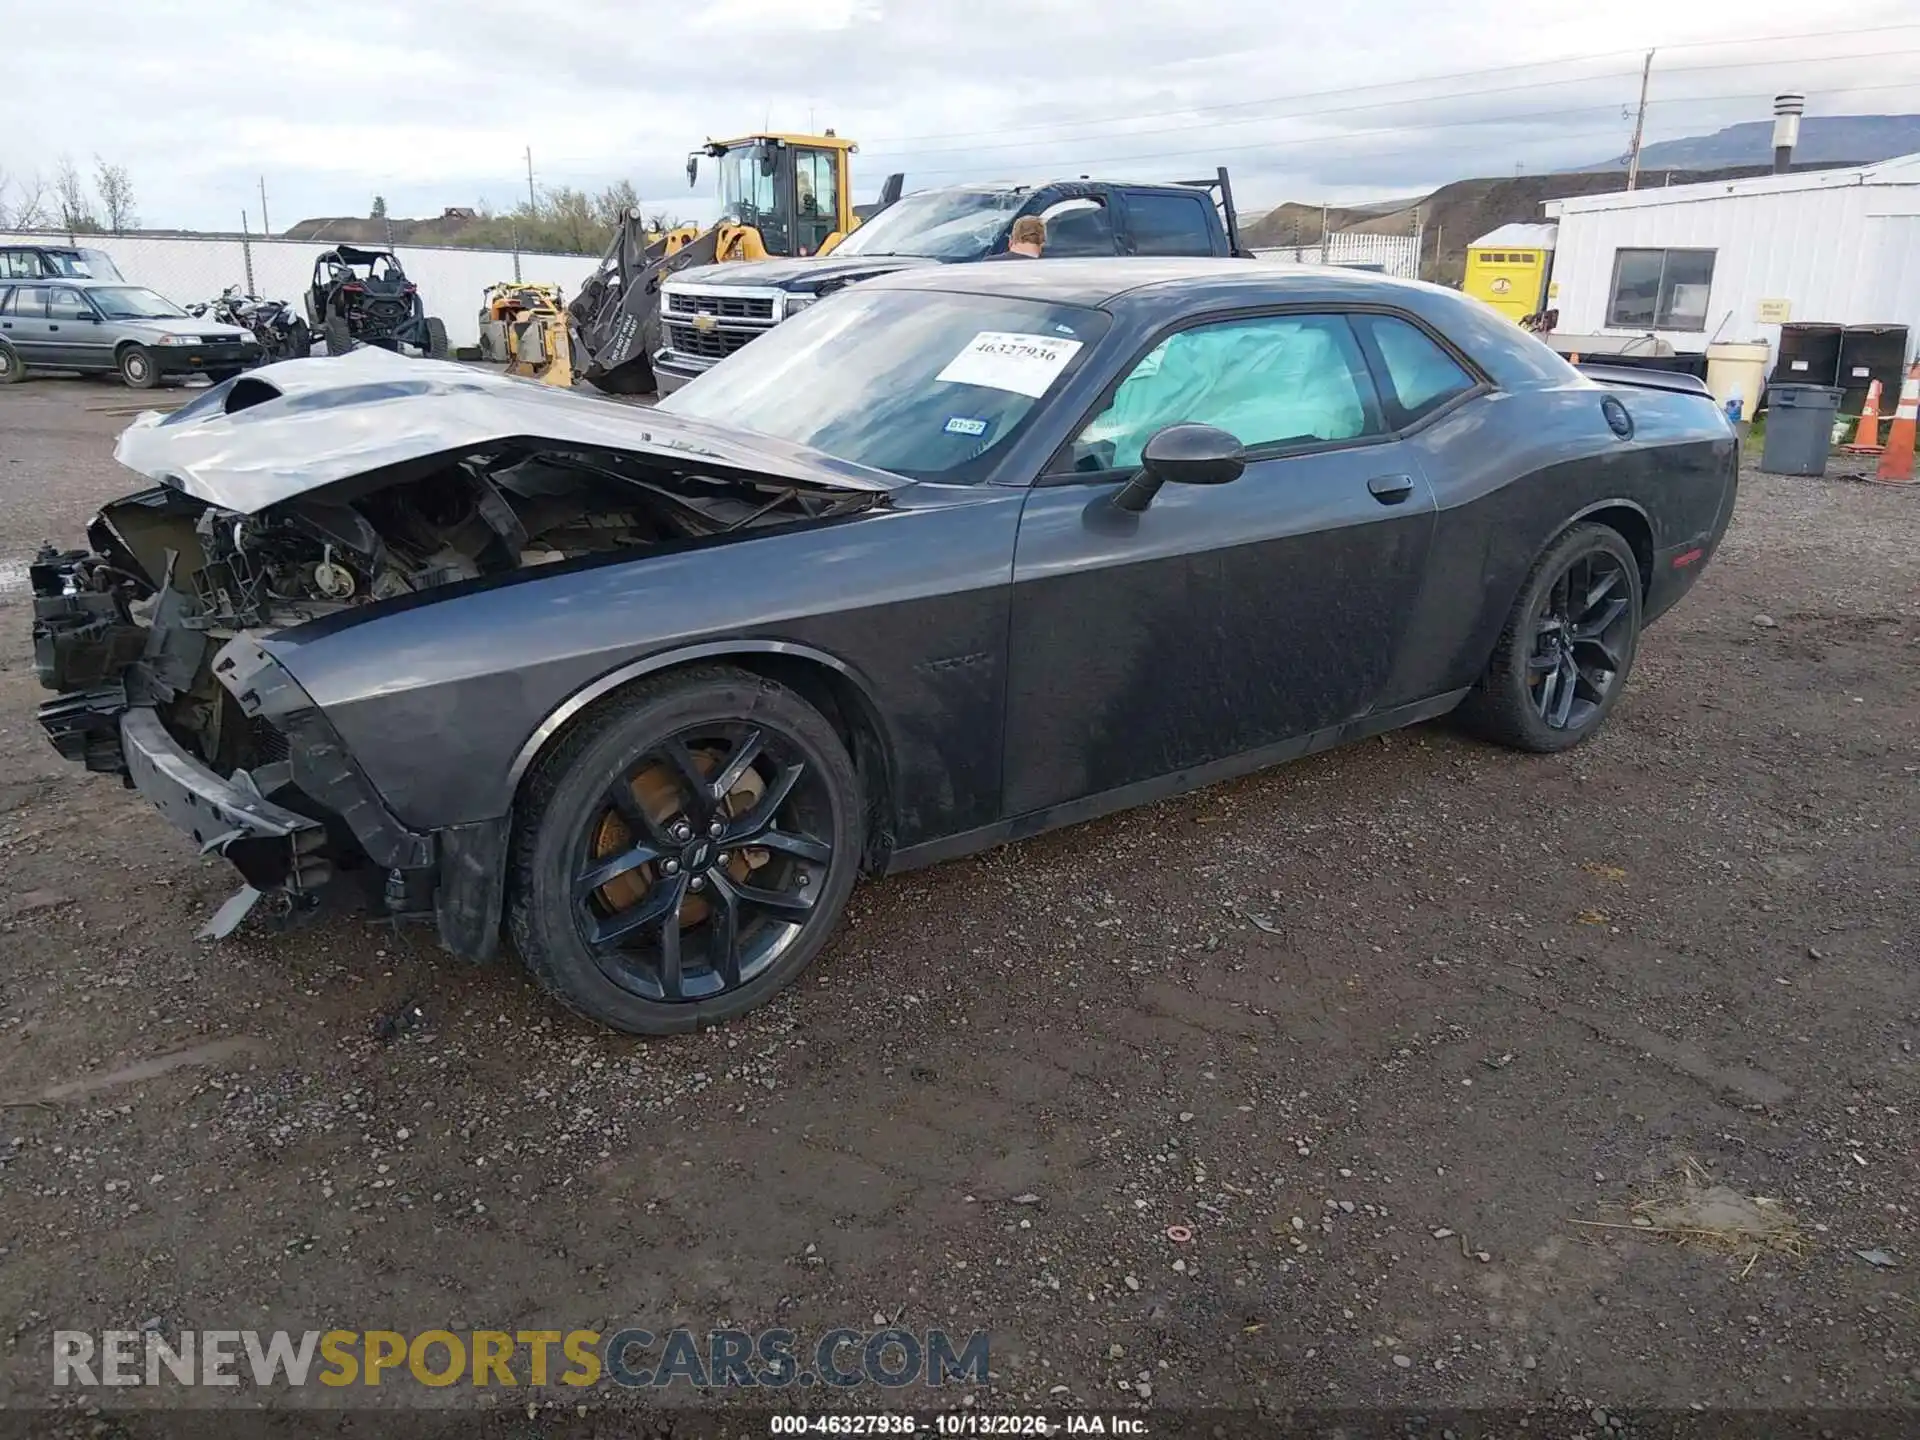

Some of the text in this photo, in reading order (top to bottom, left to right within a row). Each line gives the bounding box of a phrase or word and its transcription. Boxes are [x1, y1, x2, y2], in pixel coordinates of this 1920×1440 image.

[611, 349, 620, 361] DO
[616, 332, 625, 350] NOT
[975, 343, 1056, 361] 46327936
